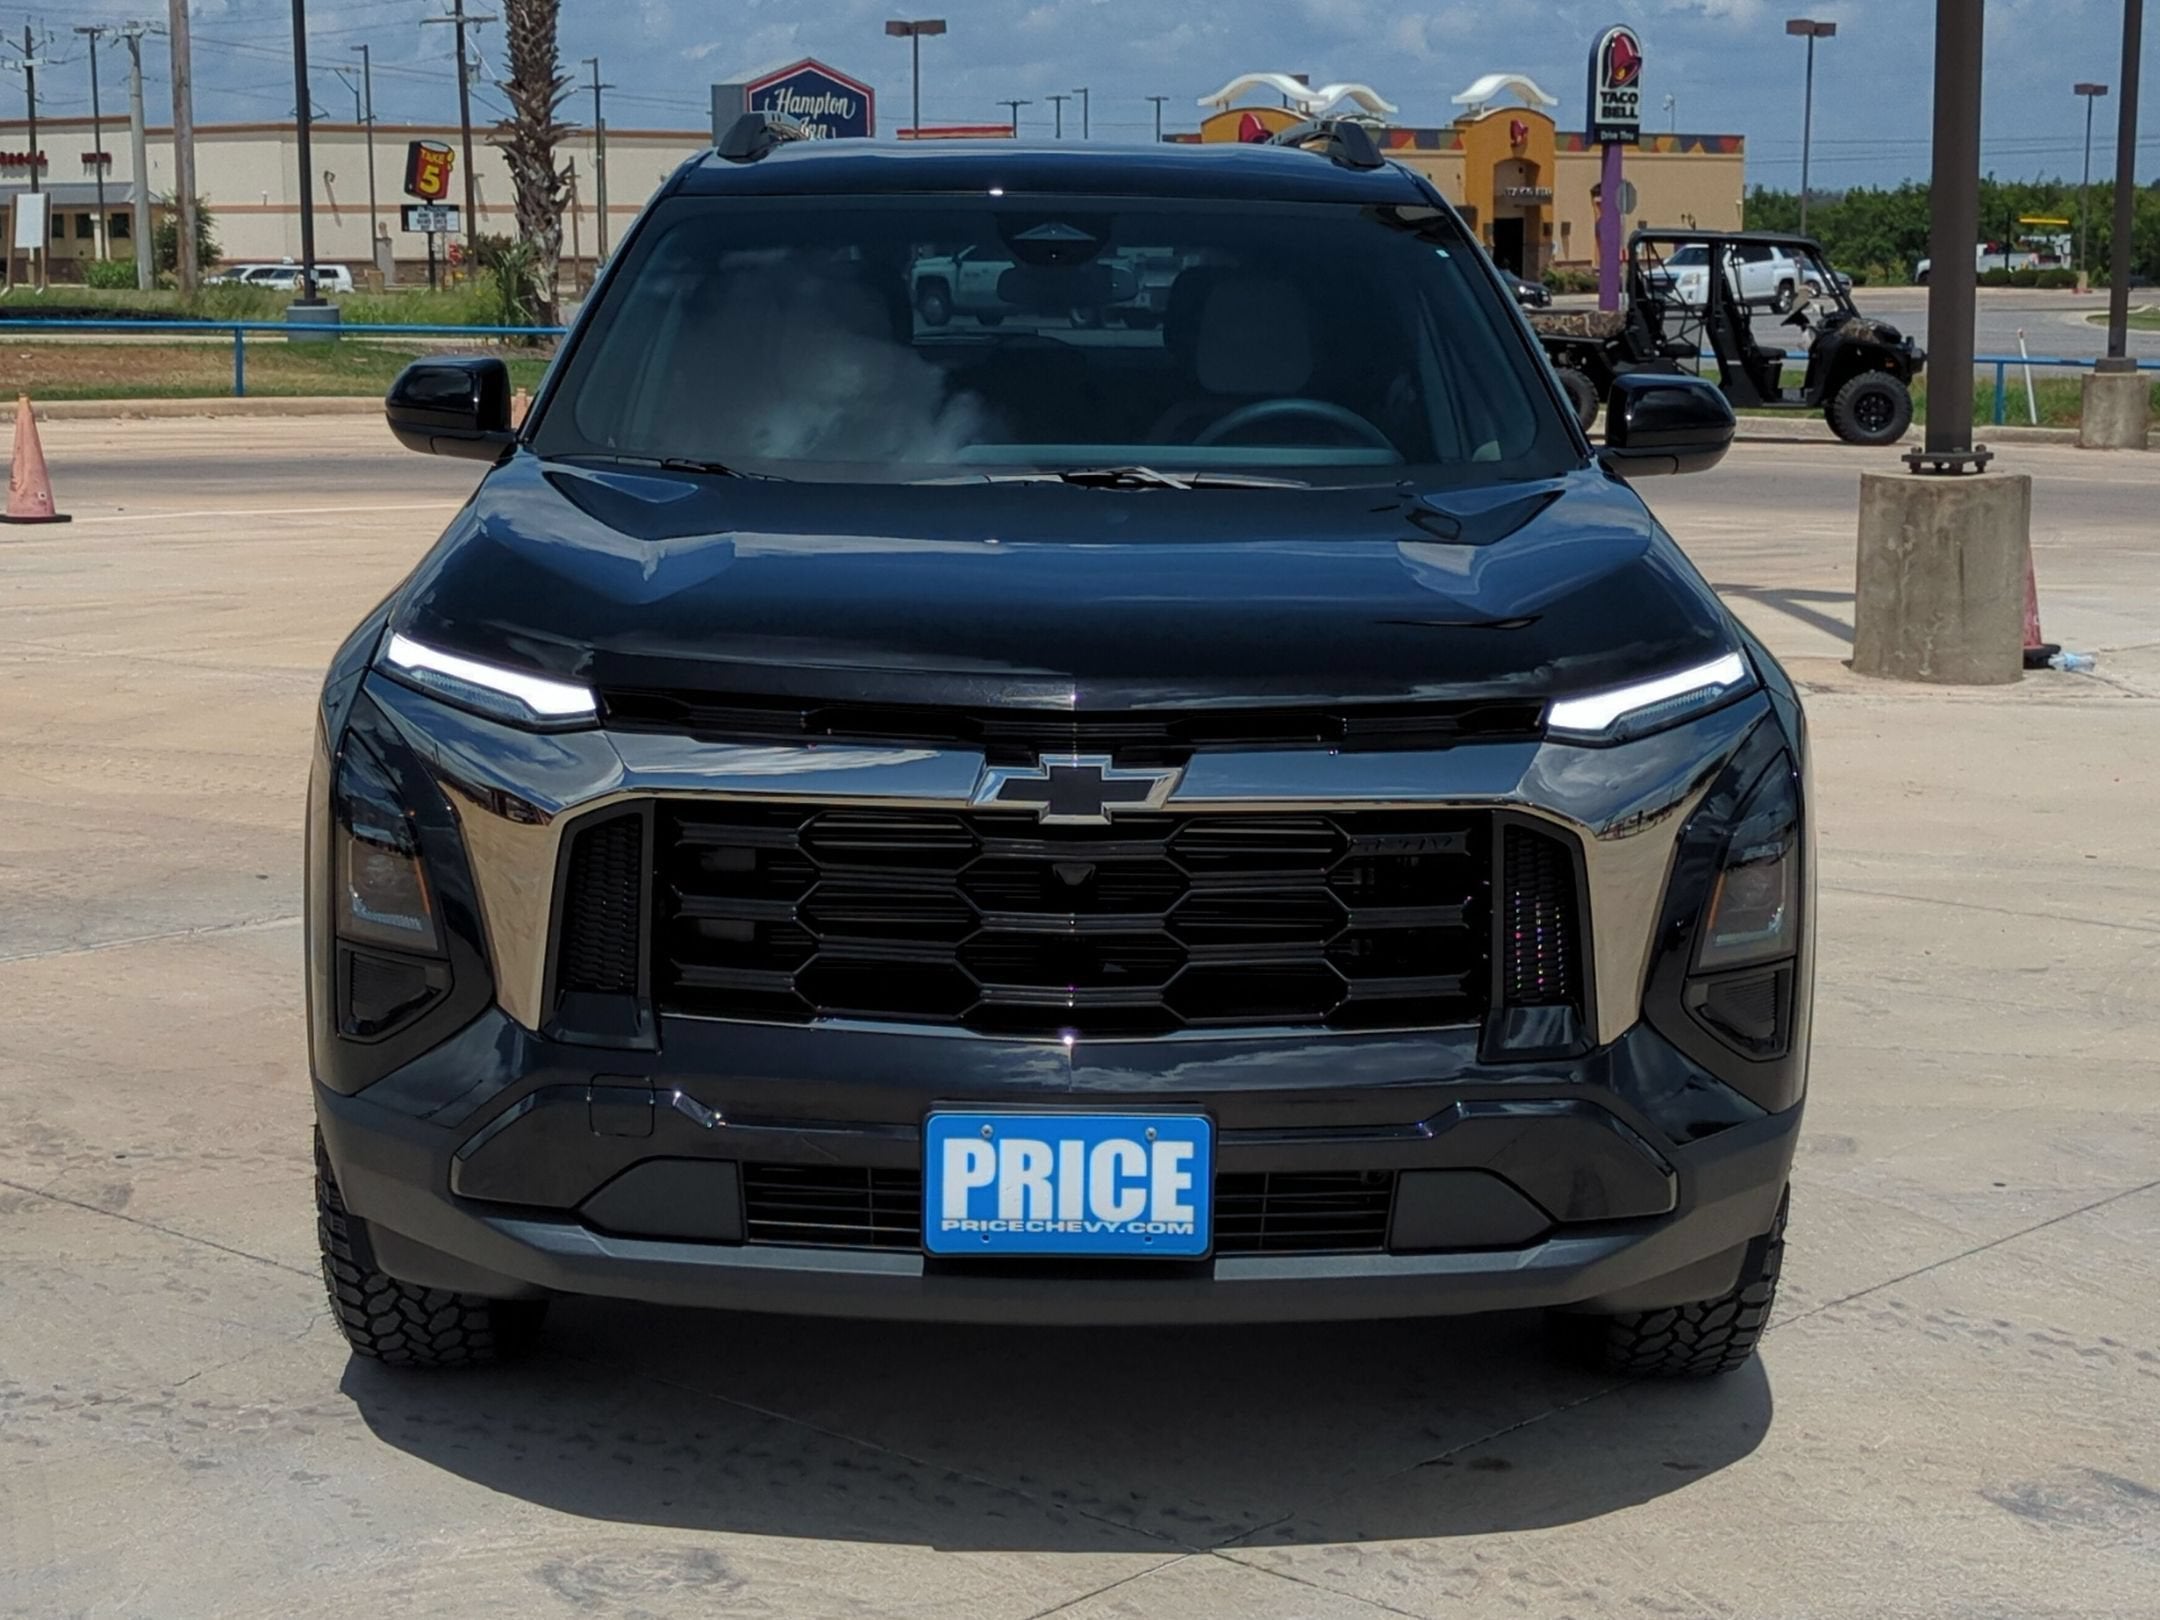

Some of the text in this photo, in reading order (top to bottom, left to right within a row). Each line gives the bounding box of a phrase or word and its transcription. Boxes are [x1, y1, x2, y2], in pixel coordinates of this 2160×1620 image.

[764, 86, 857, 120] Hampton
[1600, 91, 1639, 105] TACO
[1602, 106, 1639, 119] BELL
[419, 164, 441, 194] 5
[942, 1138, 1195, 1223] PRICE
[941, 1219, 1195, 1235] PRICECHEVY.COM
